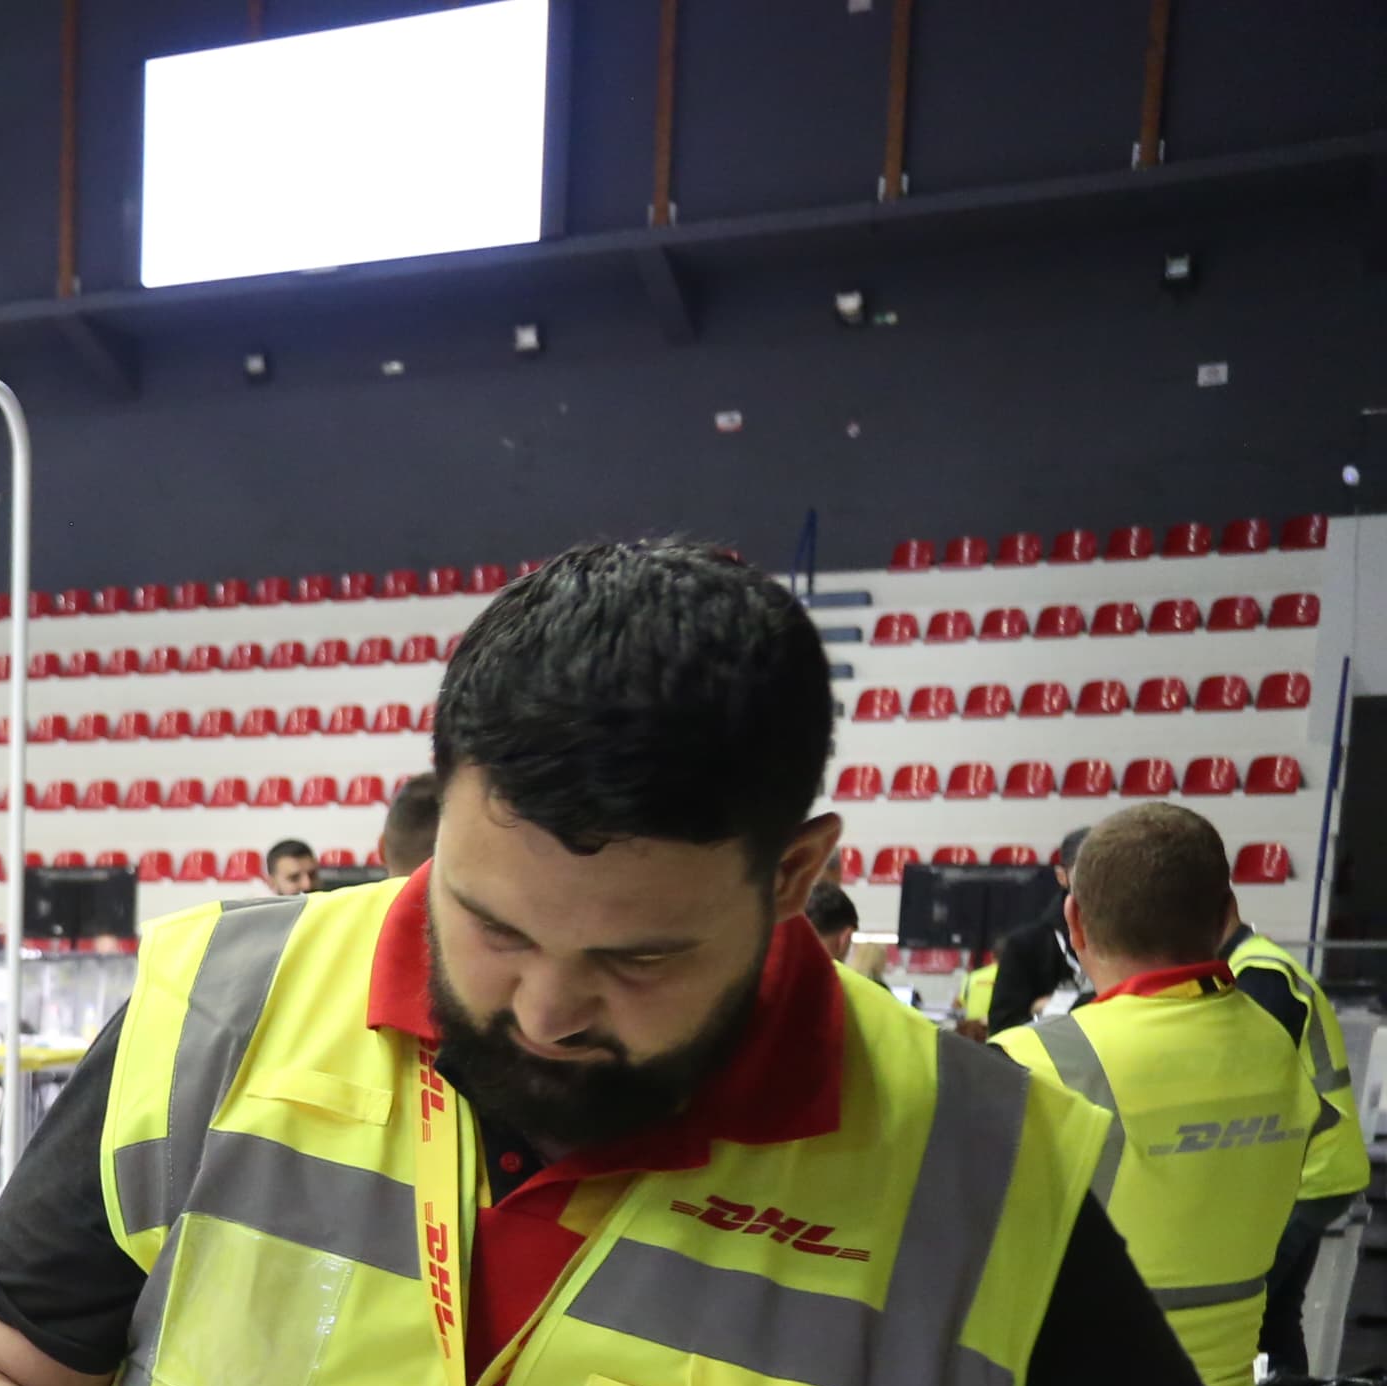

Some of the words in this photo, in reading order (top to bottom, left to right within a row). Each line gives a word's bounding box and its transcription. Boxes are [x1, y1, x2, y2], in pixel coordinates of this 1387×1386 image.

[1176, 1114, 1287, 1153] DHL
[697, 1194, 841, 1257] DHL
[425, 1221, 456, 1337] DHL
